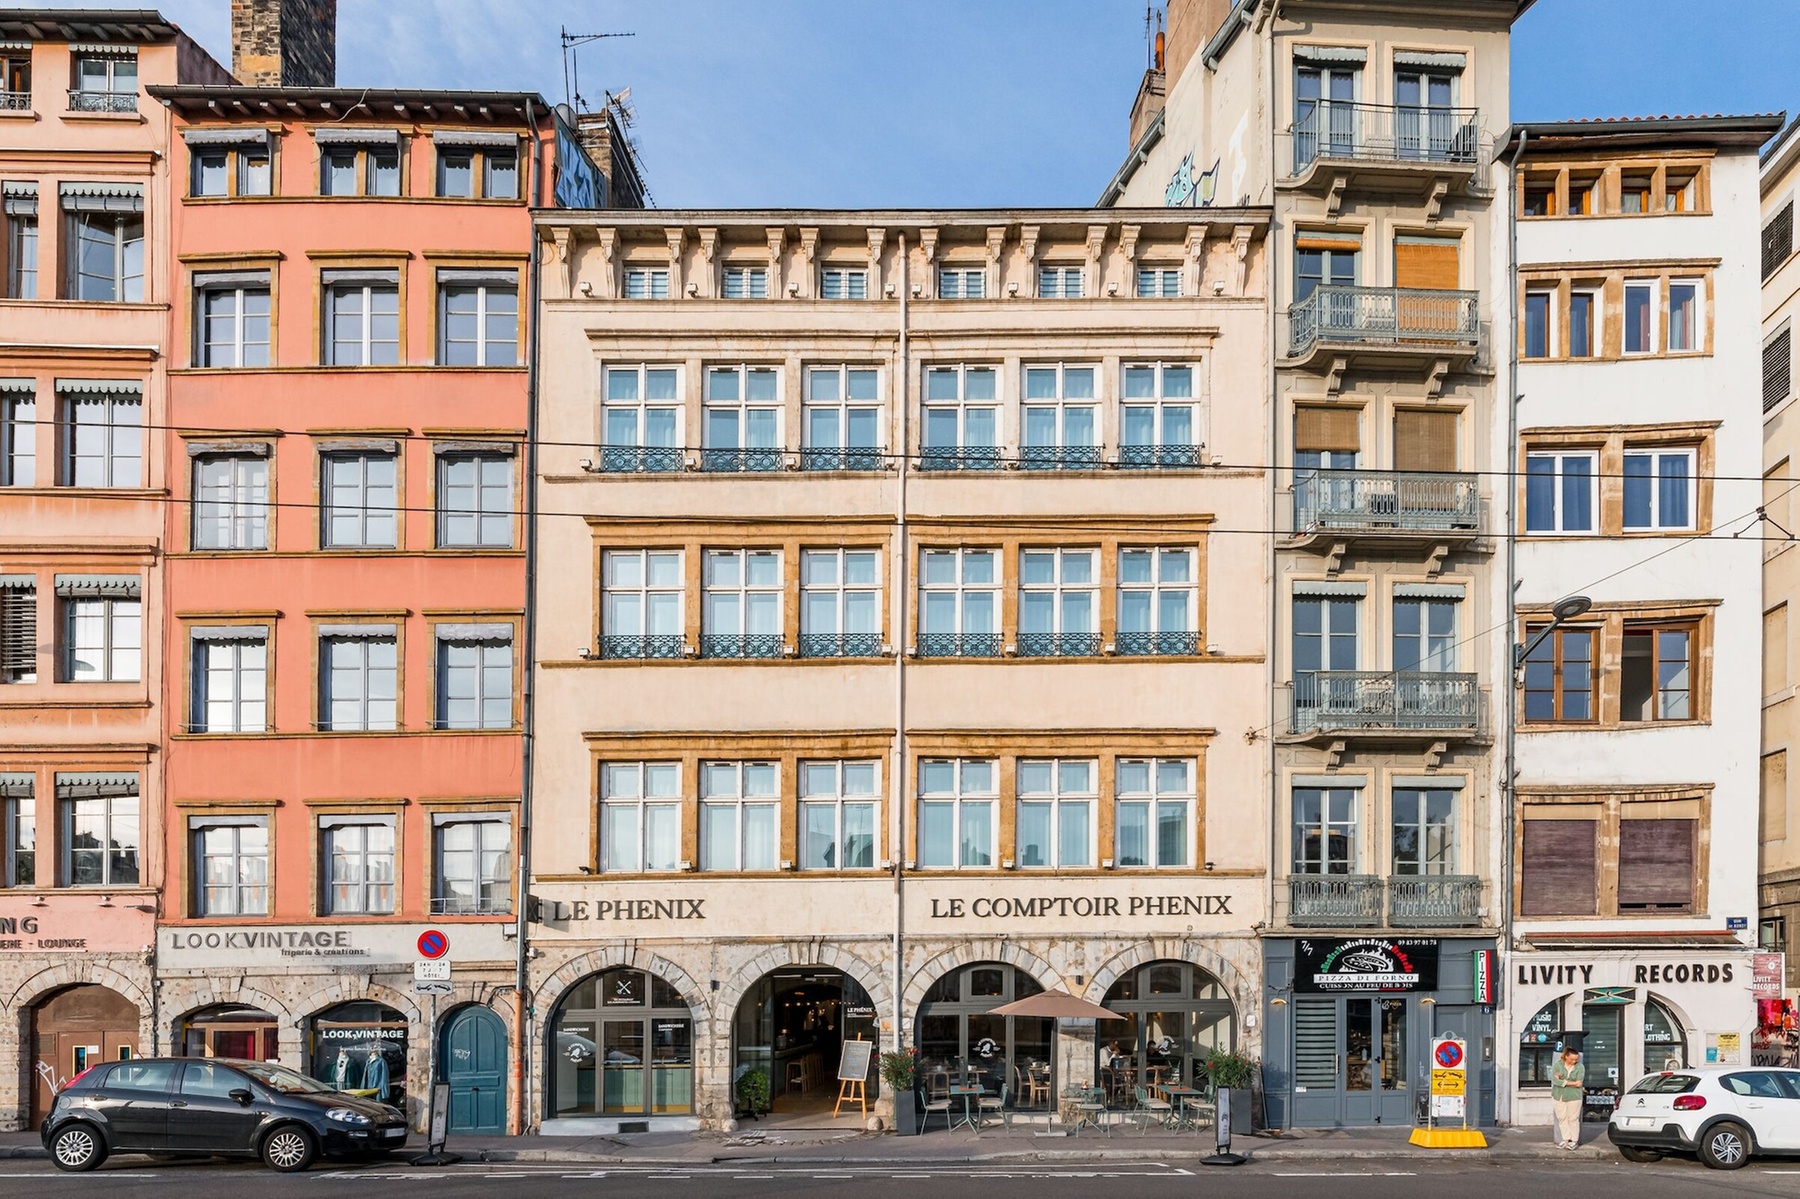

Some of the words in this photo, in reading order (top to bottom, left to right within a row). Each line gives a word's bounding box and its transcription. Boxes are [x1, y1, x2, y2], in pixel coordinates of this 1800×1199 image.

[552, 900, 590, 921] LE
[596, 899, 707, 920] PHENIX
[930, 898, 966, 918] LE
[971, 896, 1122, 918] COMPTOIR
[1128, 895, 1233, 916] PHENIX
[37, 938, 87, 948] LOUNGE
[1518, 964, 1594, 985] LIVITY
[1634, 963, 1733, 984] RECORDS
